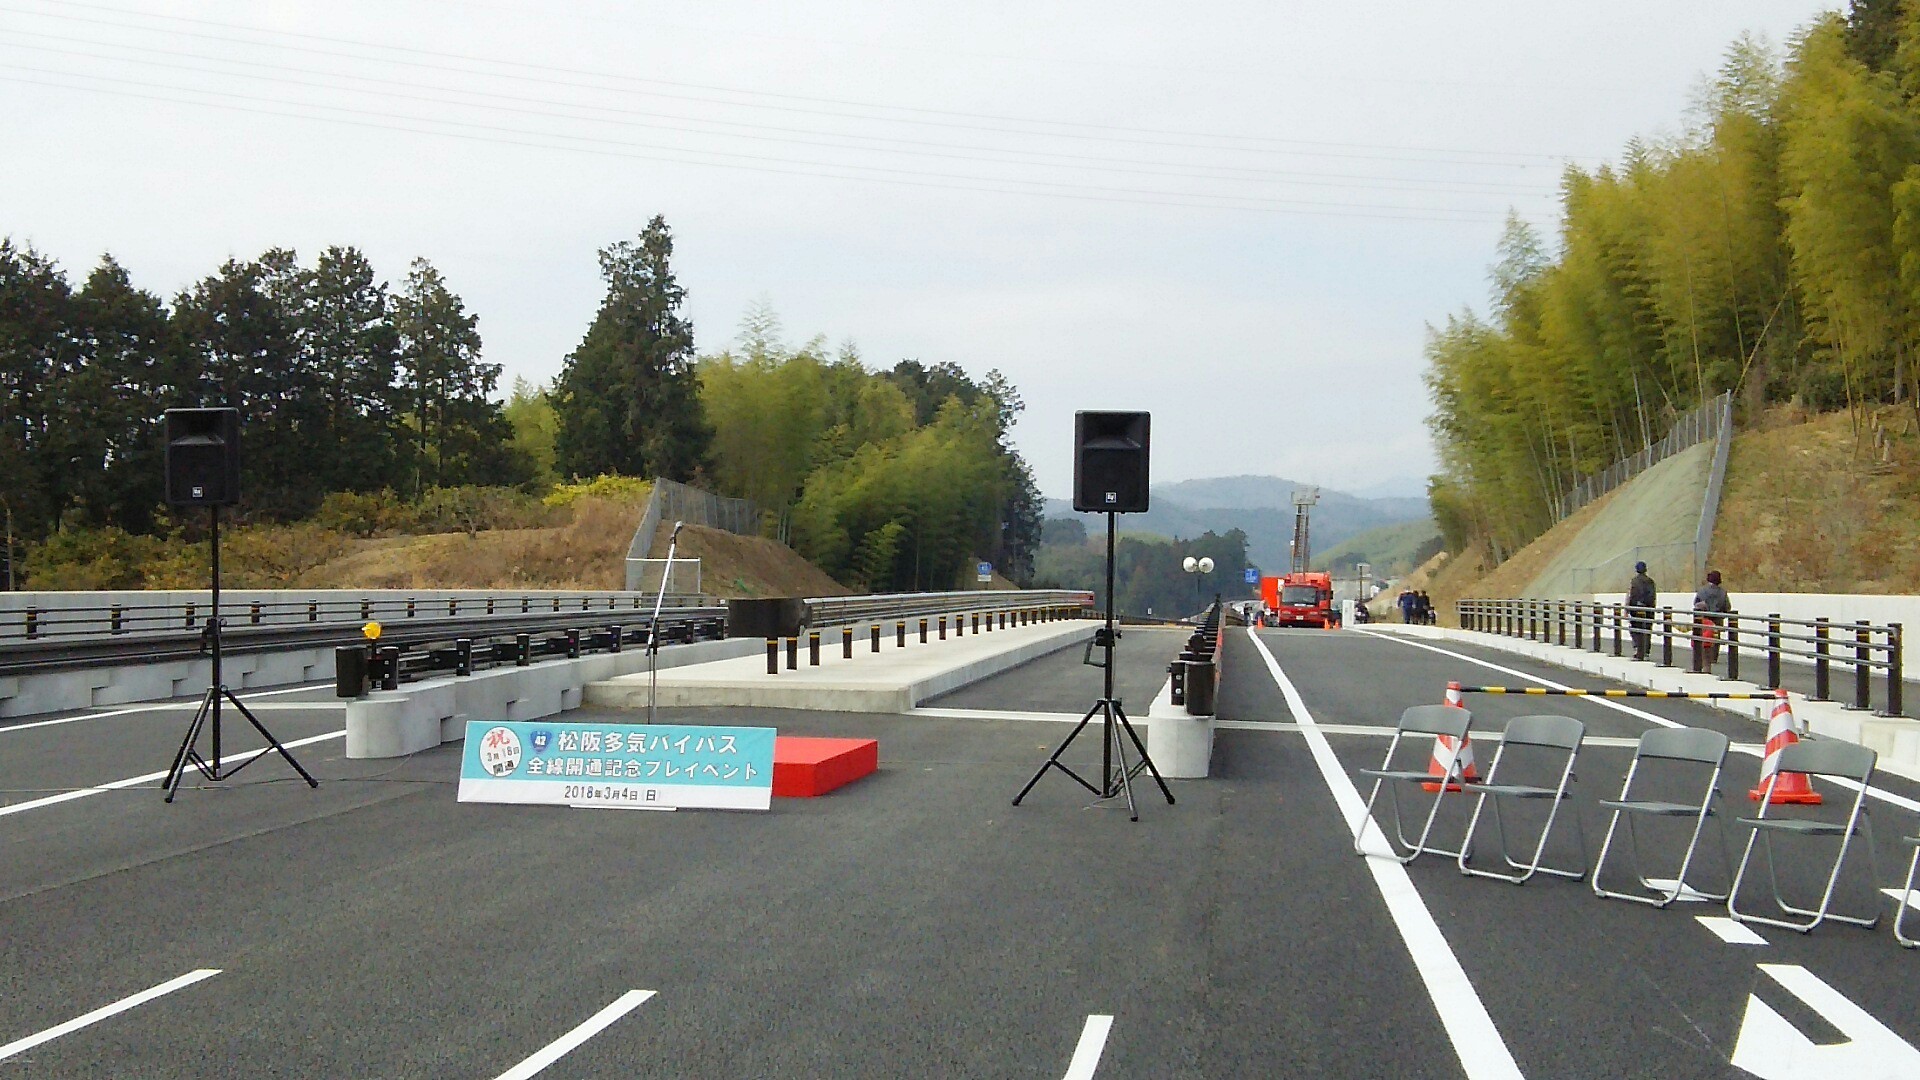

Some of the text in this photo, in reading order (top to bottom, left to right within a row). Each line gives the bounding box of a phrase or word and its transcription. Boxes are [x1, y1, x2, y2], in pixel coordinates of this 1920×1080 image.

[487, 730, 510, 748] 祝
[535, 735, 547, 745] 42
[558, 730, 737, 754] 松阪多気バイパス
[526, 757, 757, 780] 全線開通記念プレイベント
